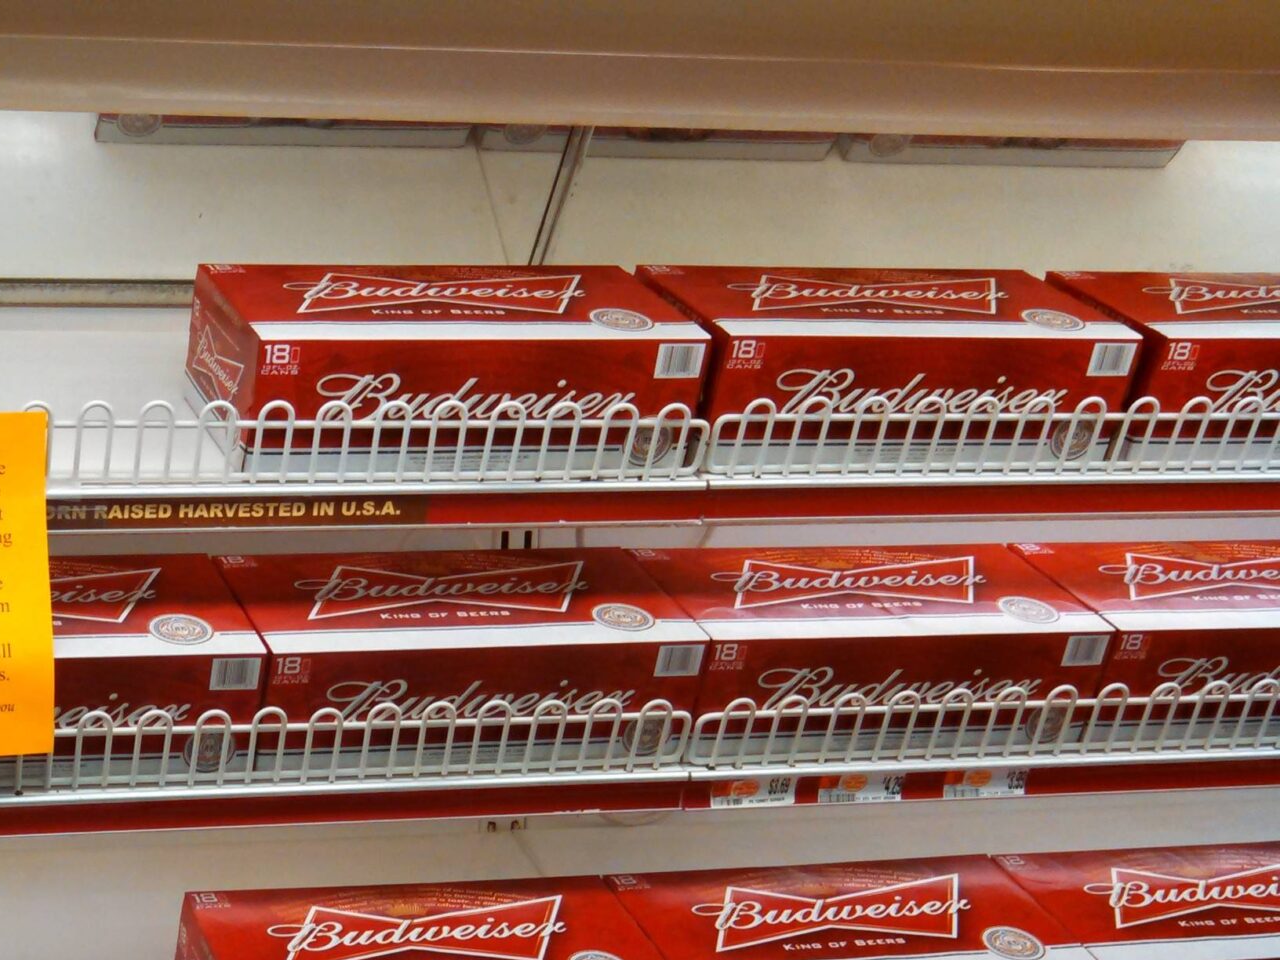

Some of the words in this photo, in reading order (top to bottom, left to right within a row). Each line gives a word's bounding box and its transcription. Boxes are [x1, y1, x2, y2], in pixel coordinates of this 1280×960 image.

[283, 279, 584, 301] Budweiser
[727, 280, 1008, 301] Budweiser
[422, 307, 444, 315] OF
[451, 307, 505, 316] BEERS
[867, 306, 887, 314] OF
[893, 307, 944, 315] BEERS
[264, 344, 290, 364] 18
[732, 339, 756, 359] 18
[1168, 342, 1192, 361] 18
[316, 373, 636, 421] Budweiser
[777, 368, 1068, 415] Budweiser
[94, 503, 171, 519] RAISED
[178, 502, 306, 519] HARVESTED
[312, 501, 334, 516] IN
[341, 500, 401, 516] U.S.A.
[295, 577, 588, 602] Budweiser
[710, 570, 986, 592] Budweiser
[871, 600, 922, 608] BEERS
[429, 611, 449, 619] OF
[457, 609, 510, 618] BEERS
[715, 643, 738, 661] 18
[1121, 634, 1143, 651] 18
[276, 656, 301, 675] 18
[758, 667, 1041, 712] Budweiser
[327, 679, 635, 722] Budweiser
[610, 876, 637, 885] 18
[191, 892, 217, 903] 18
[692, 893, 970, 931] Budweiser
[1178, 919, 1215, 928] KING
[1220, 918, 1238, 926] OF
[267, 914, 566, 952] Budweiser
[782, 942, 822, 951] KING
[829, 940, 848, 949] OF
[855, 936, 906, 946] BEERS
